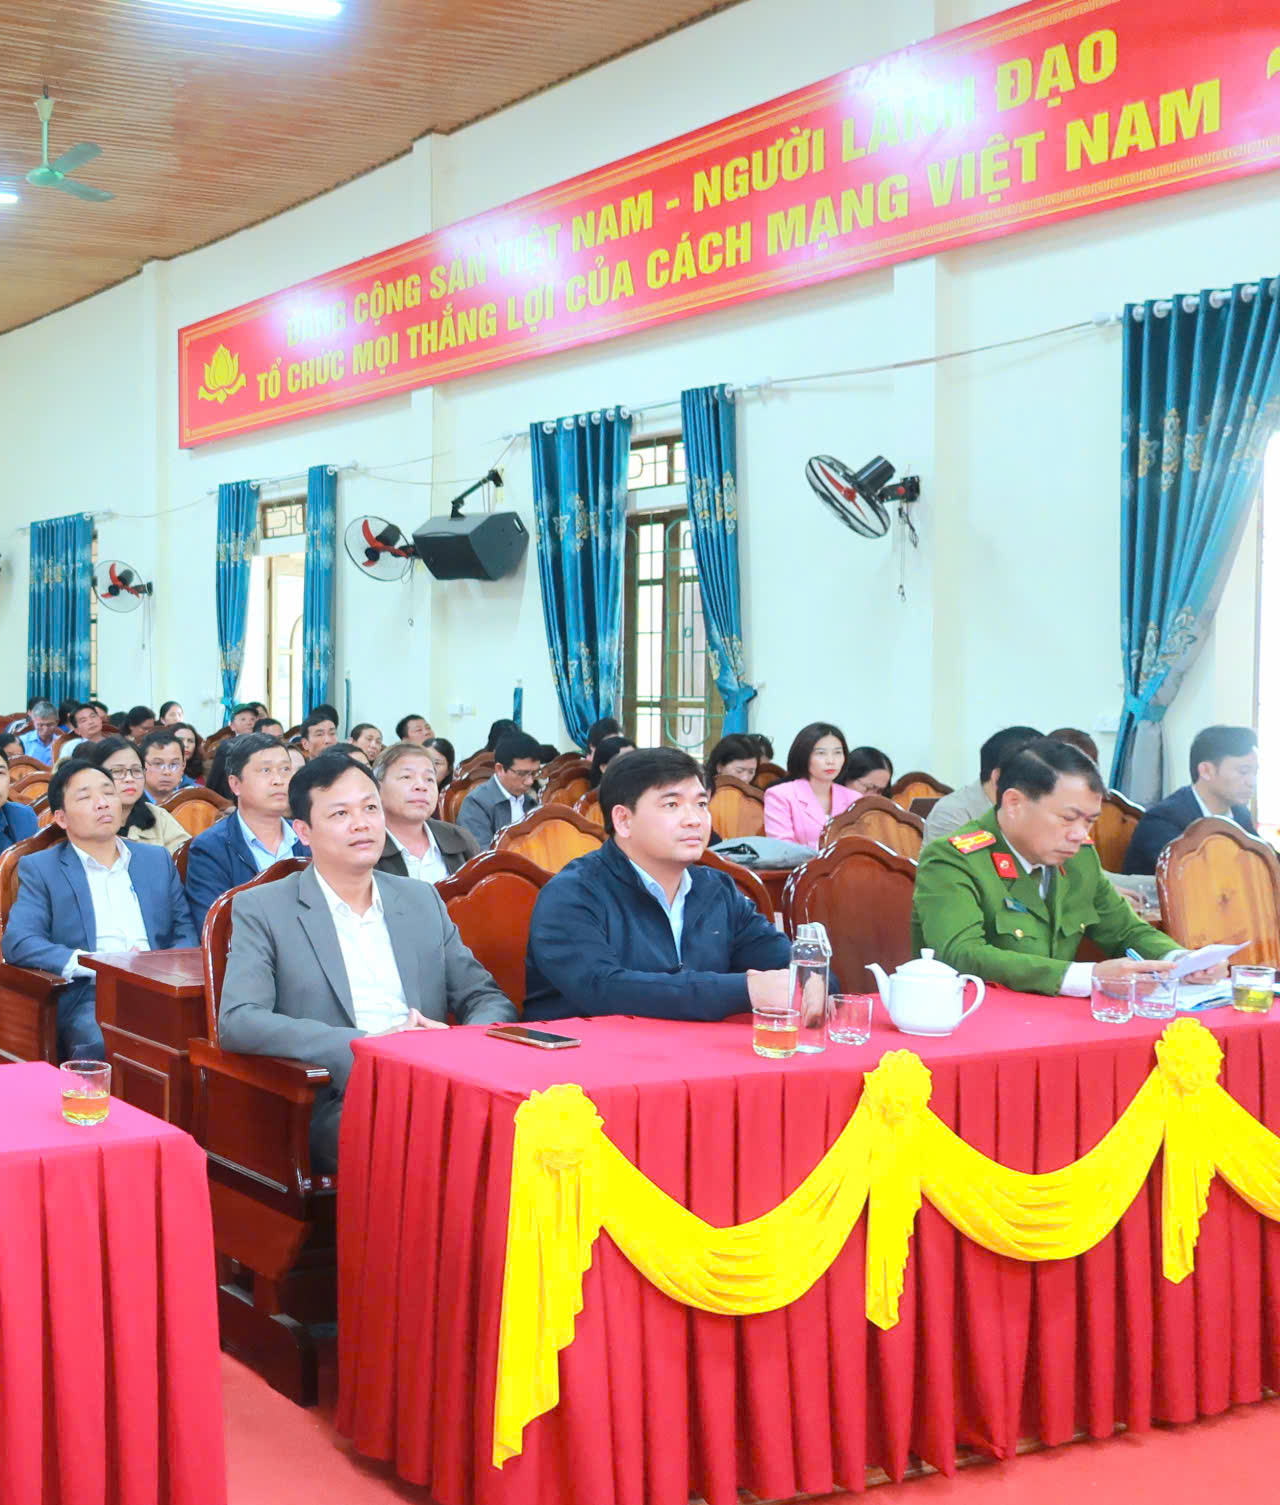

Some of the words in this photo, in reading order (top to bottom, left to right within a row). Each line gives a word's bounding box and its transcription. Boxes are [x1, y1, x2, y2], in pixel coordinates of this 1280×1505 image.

[256, 357, 281, 401] TỔ
[288, 346, 345, 393] CHỨC
[352, 333, 399, 376] MỌI
[407, 302, 497, 358] THẮNG
[508, 282, 554, 337] LỢI
[566, 255, 635, 313] CỦA
[646, 221, 751, 288] CÁCH
[766, 174, 908, 256] MẠNG
[927, 131, 1046, 208] VIỆT
[1066, 78, 1220, 172] NAM
[353, 274, 422, 326] CỘNG
[429, 248, 487, 300] SẢN
[572, 189, 653, 250] NAM
[693, 125, 824, 213] NGƯỜI
[995, 28, 1117, 112] ĐẠO
